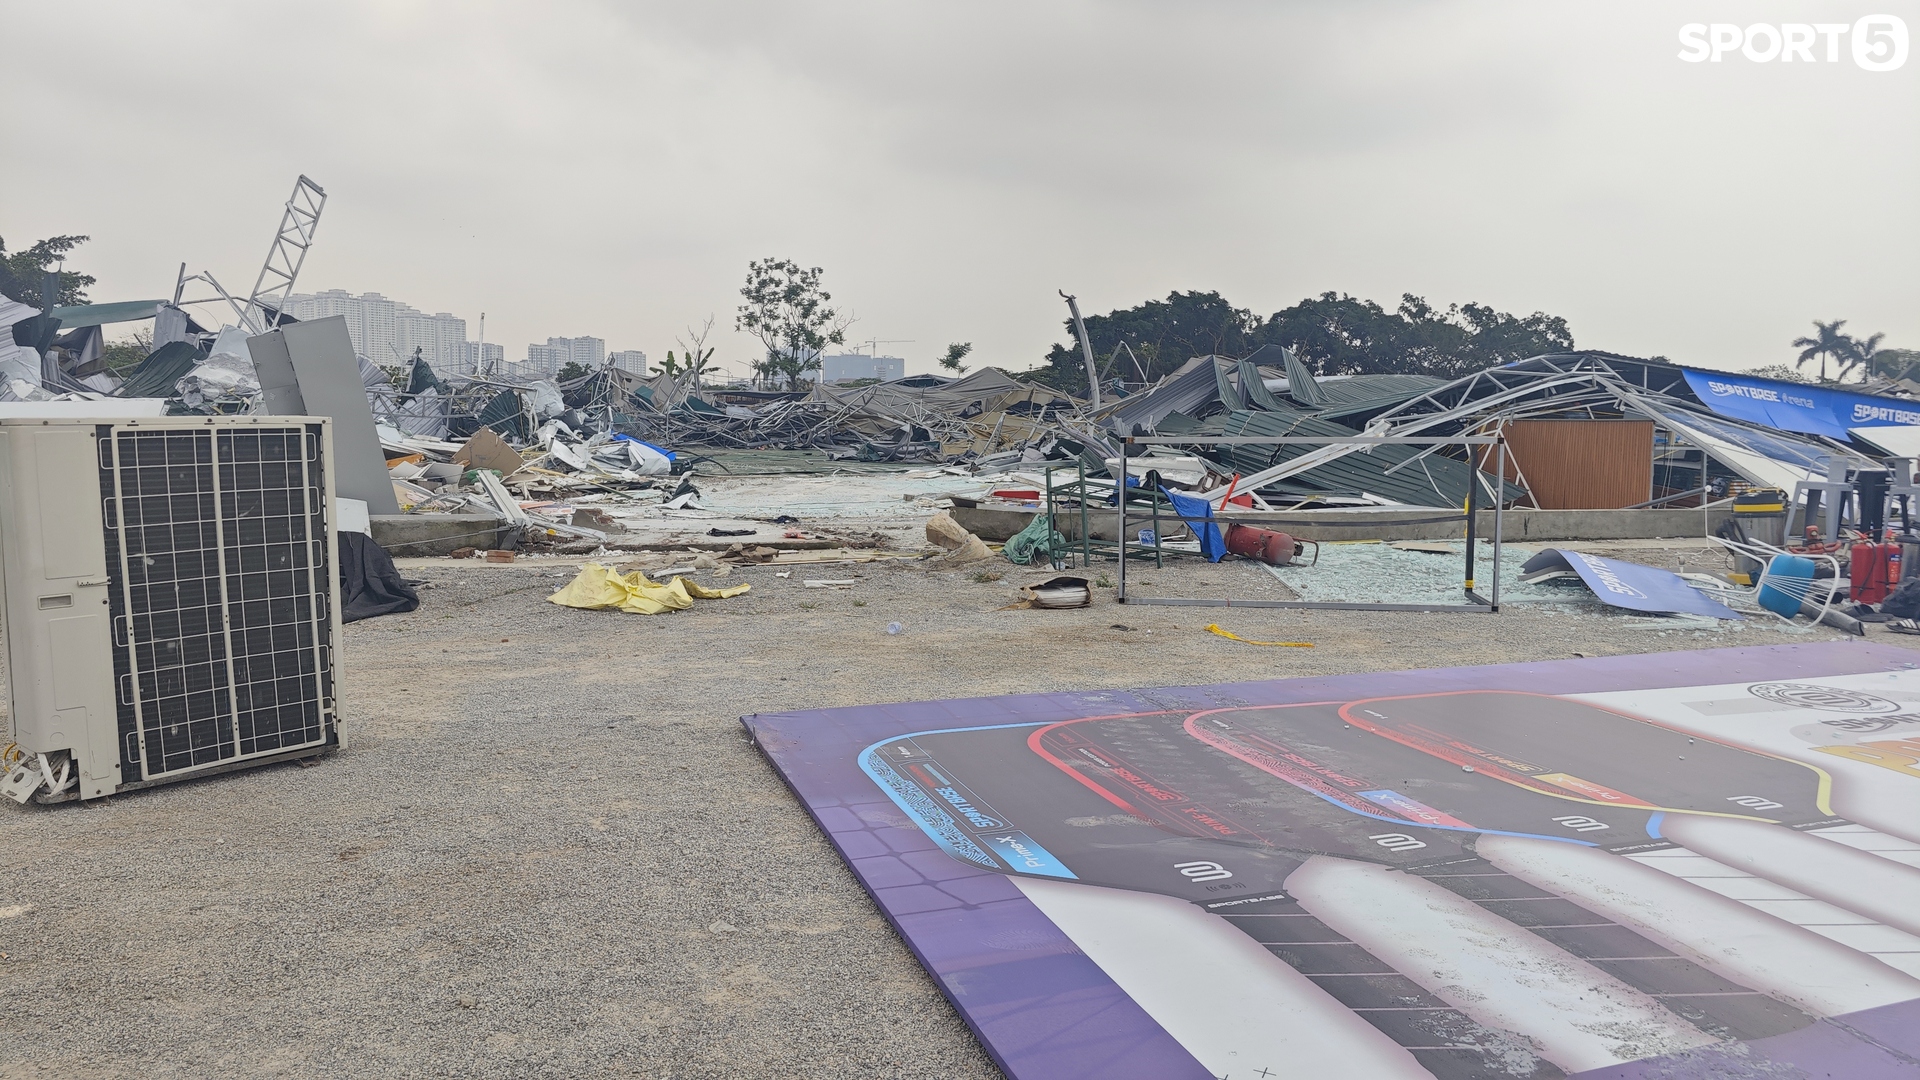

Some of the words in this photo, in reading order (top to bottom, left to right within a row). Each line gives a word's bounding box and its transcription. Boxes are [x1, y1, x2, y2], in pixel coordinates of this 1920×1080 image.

[1708, 381, 1781, 403] SPORTBASE
[1782, 392, 1815, 409] Arena
[935, 786, 1000, 828] SPORTBASE
[1207, 894, 1285, 909] SPORTBASE
